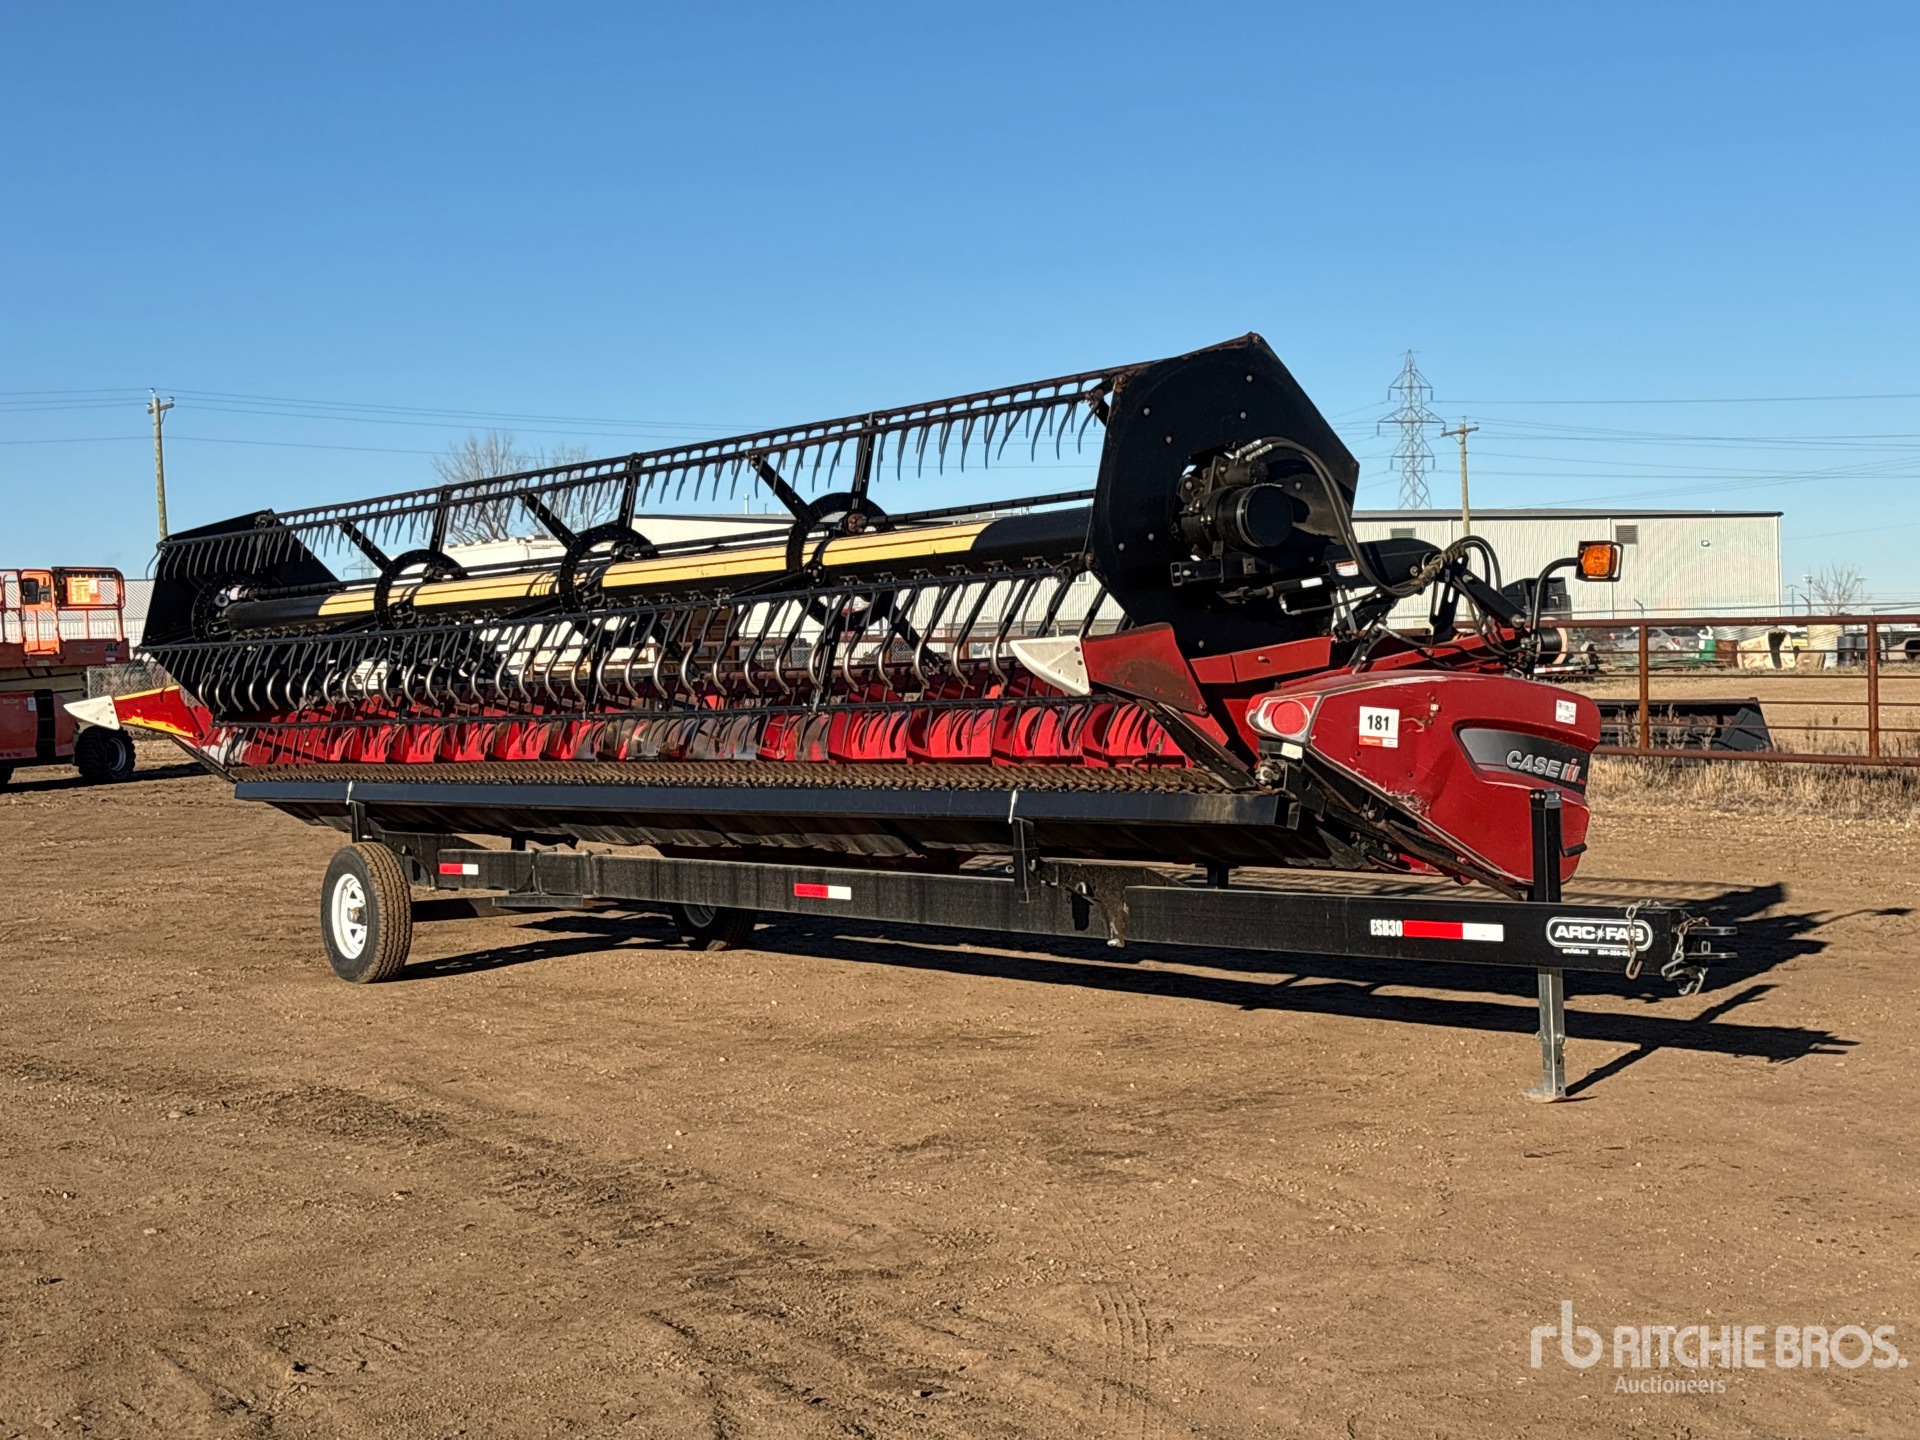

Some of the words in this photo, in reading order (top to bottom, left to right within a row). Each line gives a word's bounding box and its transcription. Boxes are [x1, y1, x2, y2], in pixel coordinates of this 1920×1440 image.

[1367, 714, 1390, 731] 181
[1506, 750, 1562, 778] CASE
[1370, 919, 1403, 937] ESB30
[1554, 925, 1596, 940] ARC
